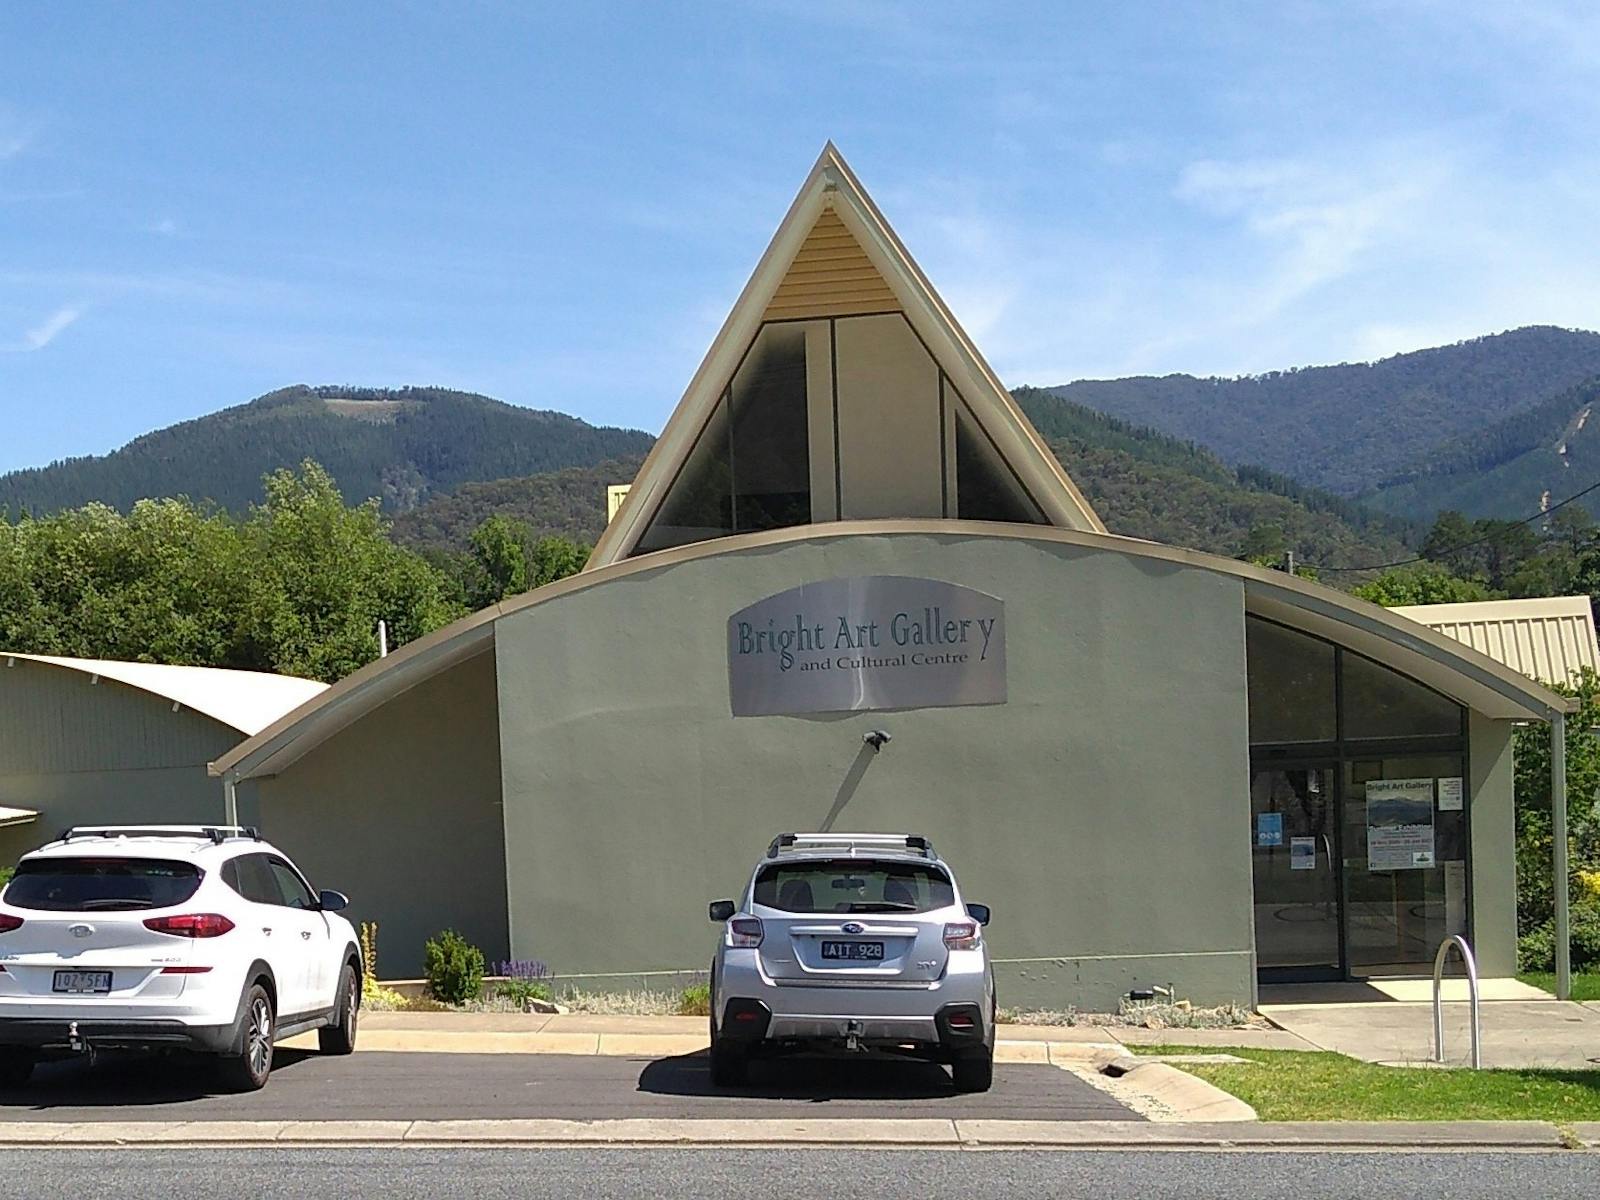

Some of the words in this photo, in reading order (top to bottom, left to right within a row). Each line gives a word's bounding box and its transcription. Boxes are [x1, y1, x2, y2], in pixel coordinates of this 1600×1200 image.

[738, 614, 825, 672] Bright
[834, 616, 879, 649] Art
[891, 607, 995, 661] Gallery
[800, 658, 831, 671] and
[836, 654, 906, 669] Cultural
[911, 653, 968, 665] Centre
[1366, 784, 1390, 792] Bright
[1405, 782, 1432, 791] Gallery
[828, 944, 852, 956] AIT
[859, 944, 882, 957] 928
